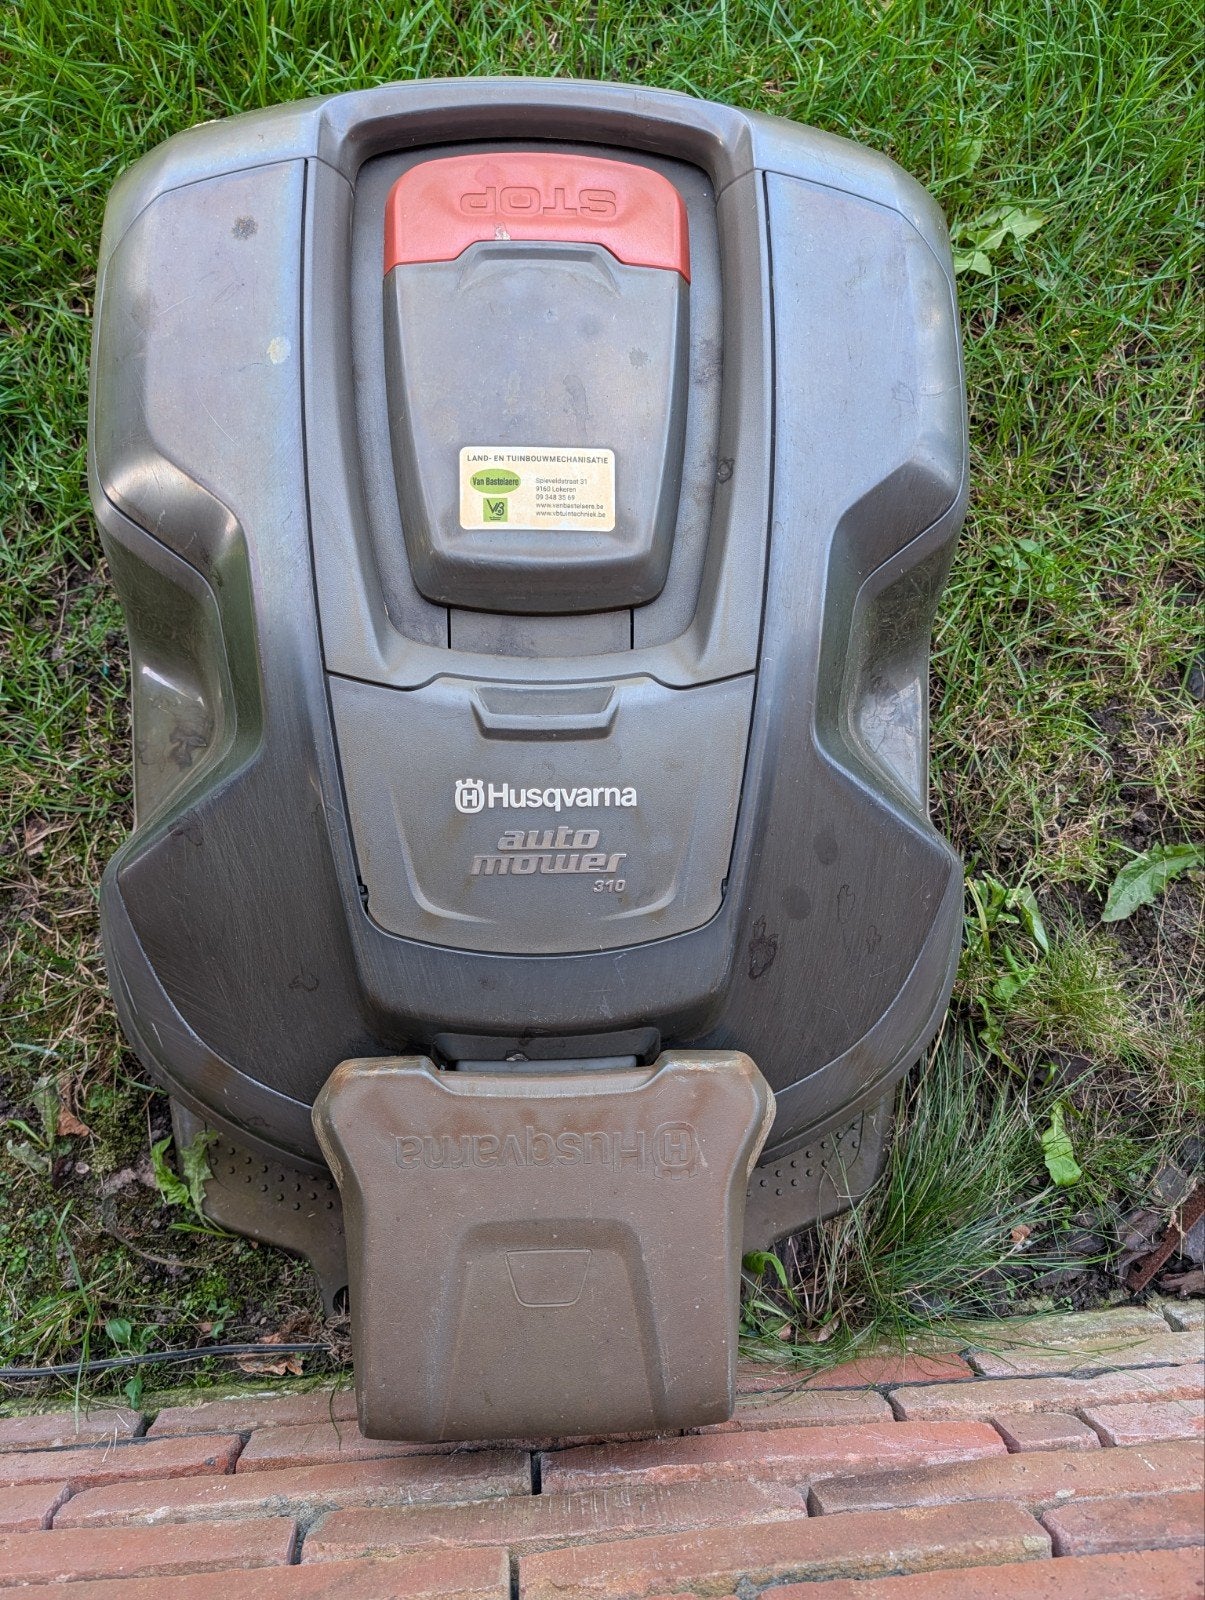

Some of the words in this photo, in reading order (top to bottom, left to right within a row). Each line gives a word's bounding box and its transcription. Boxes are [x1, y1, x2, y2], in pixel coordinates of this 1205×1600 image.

[460, 186, 617, 218] STOP
[467, 454, 492, 462] LAND-
[493, 454, 505, 462] EN
[507, 455, 609, 464] TUINBOUWMECHANISATIE
[473, 477, 484, 485] Van
[486, 477, 519, 486] Bastelaere
[488, 783, 638, 812] Husqvarna
[497, 825, 600, 850] auto
[470, 853, 627, 876] mower
[592, 879, 627, 893] 310
[395, 1125, 647, 1174] Husqvarna
